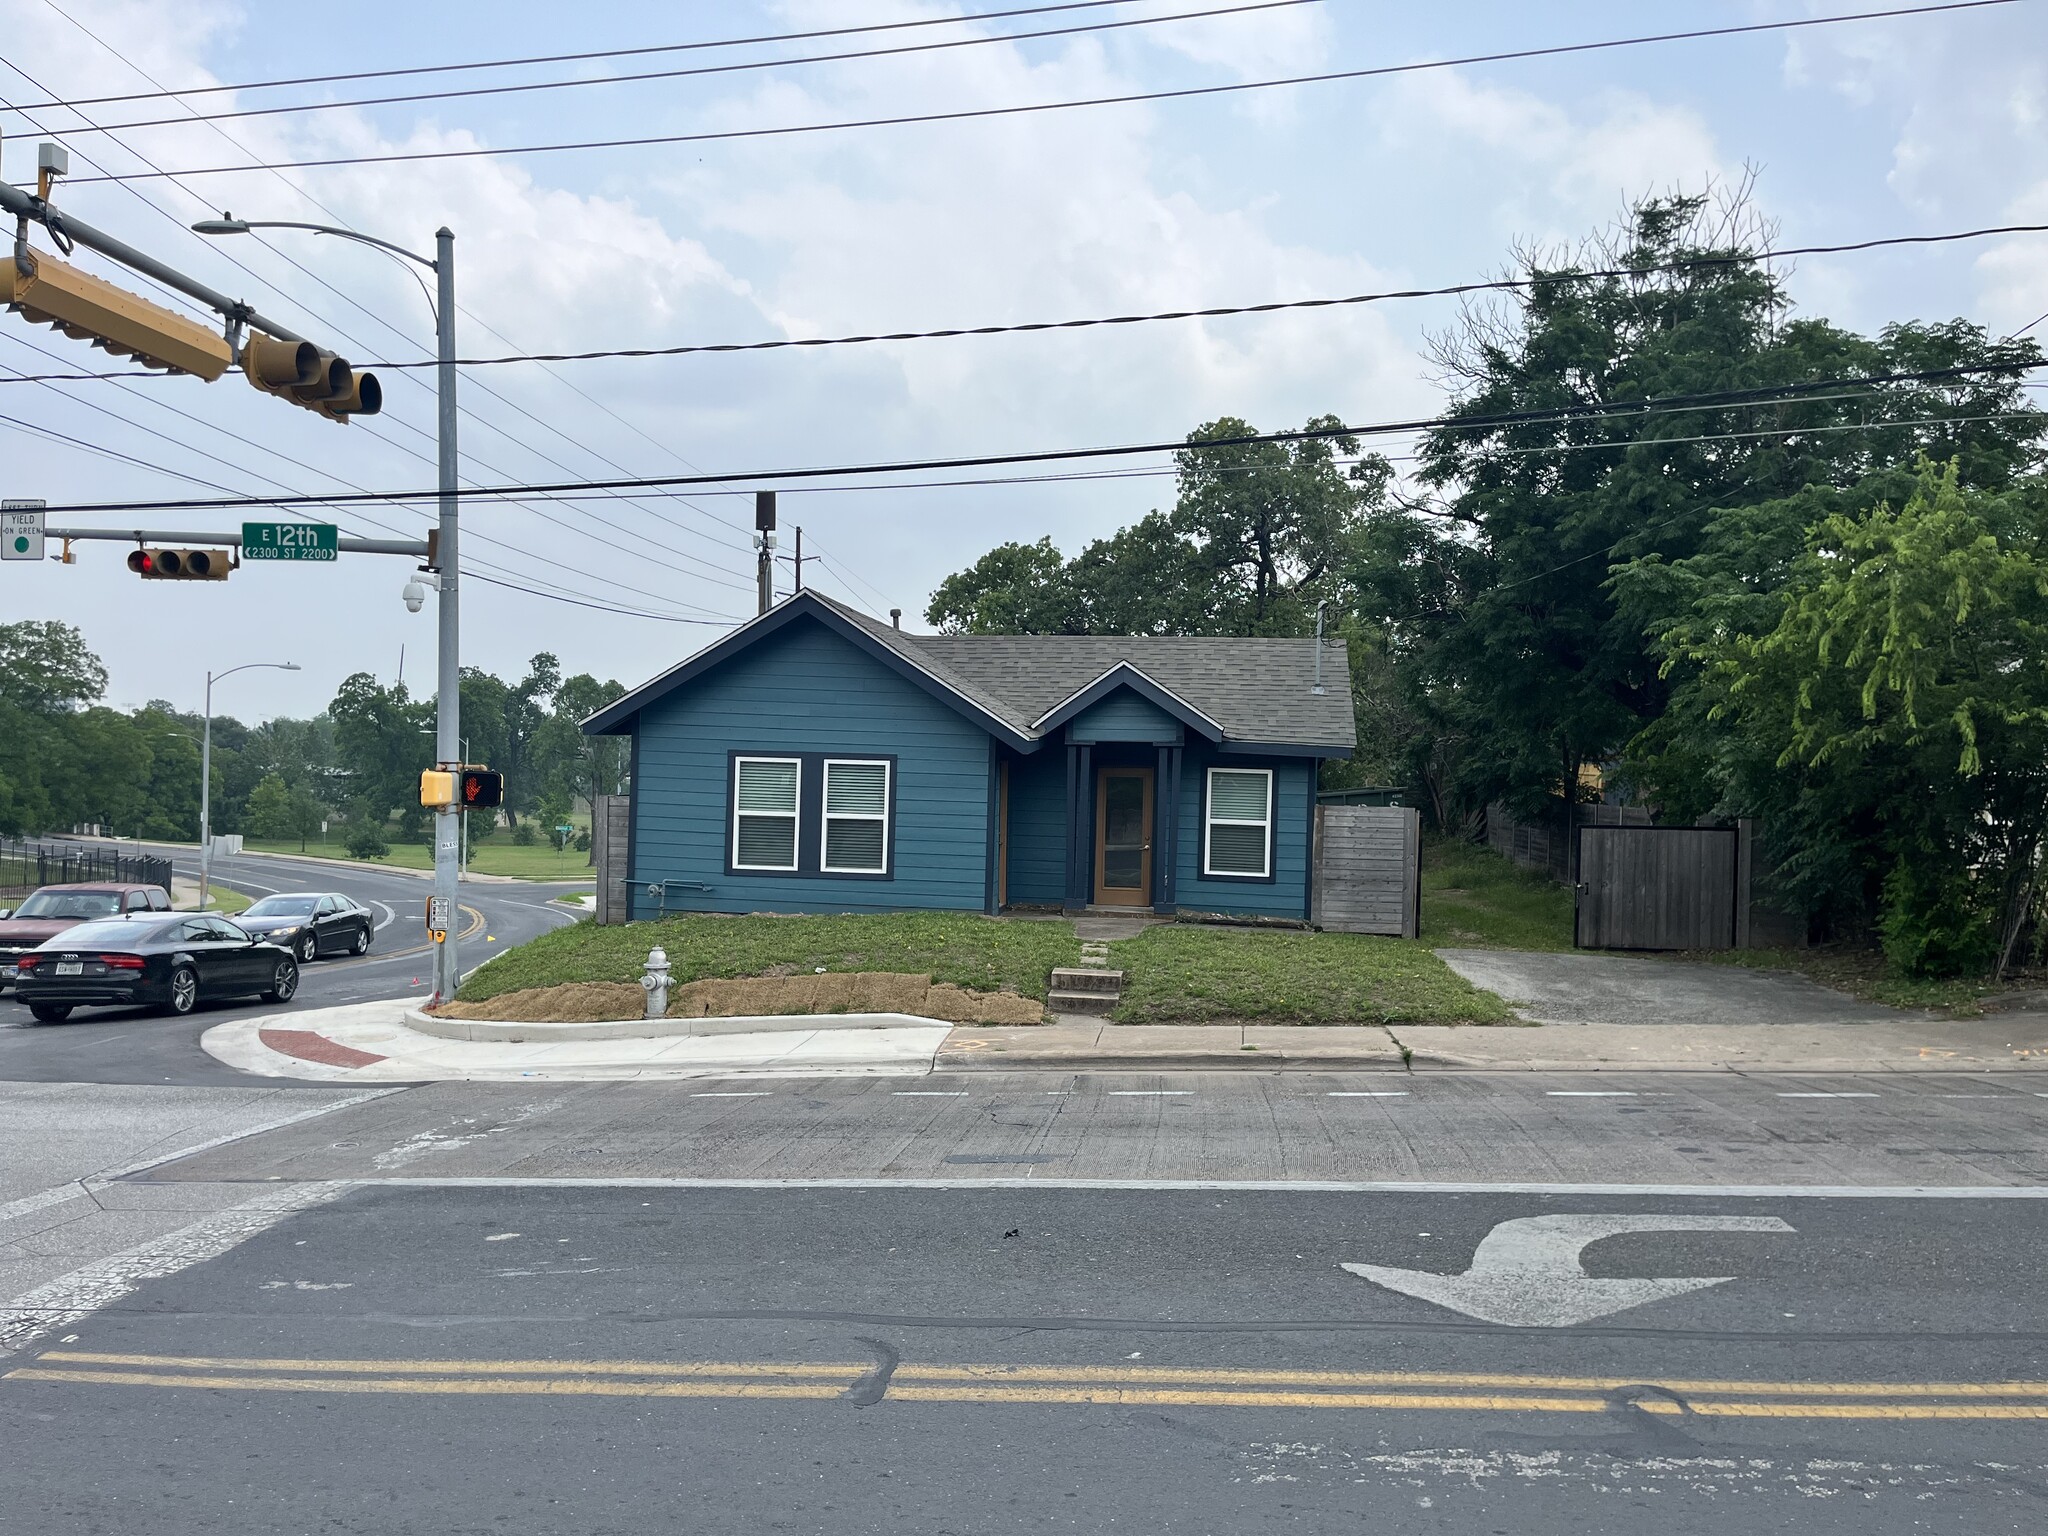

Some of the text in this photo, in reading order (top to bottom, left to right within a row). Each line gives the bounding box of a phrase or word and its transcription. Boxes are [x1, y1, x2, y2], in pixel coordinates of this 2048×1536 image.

[12, 515, 35, 524] YIELD
[262, 525, 318, 547] E 12th
[252, 547, 328, 559] 2300 ST 2200
